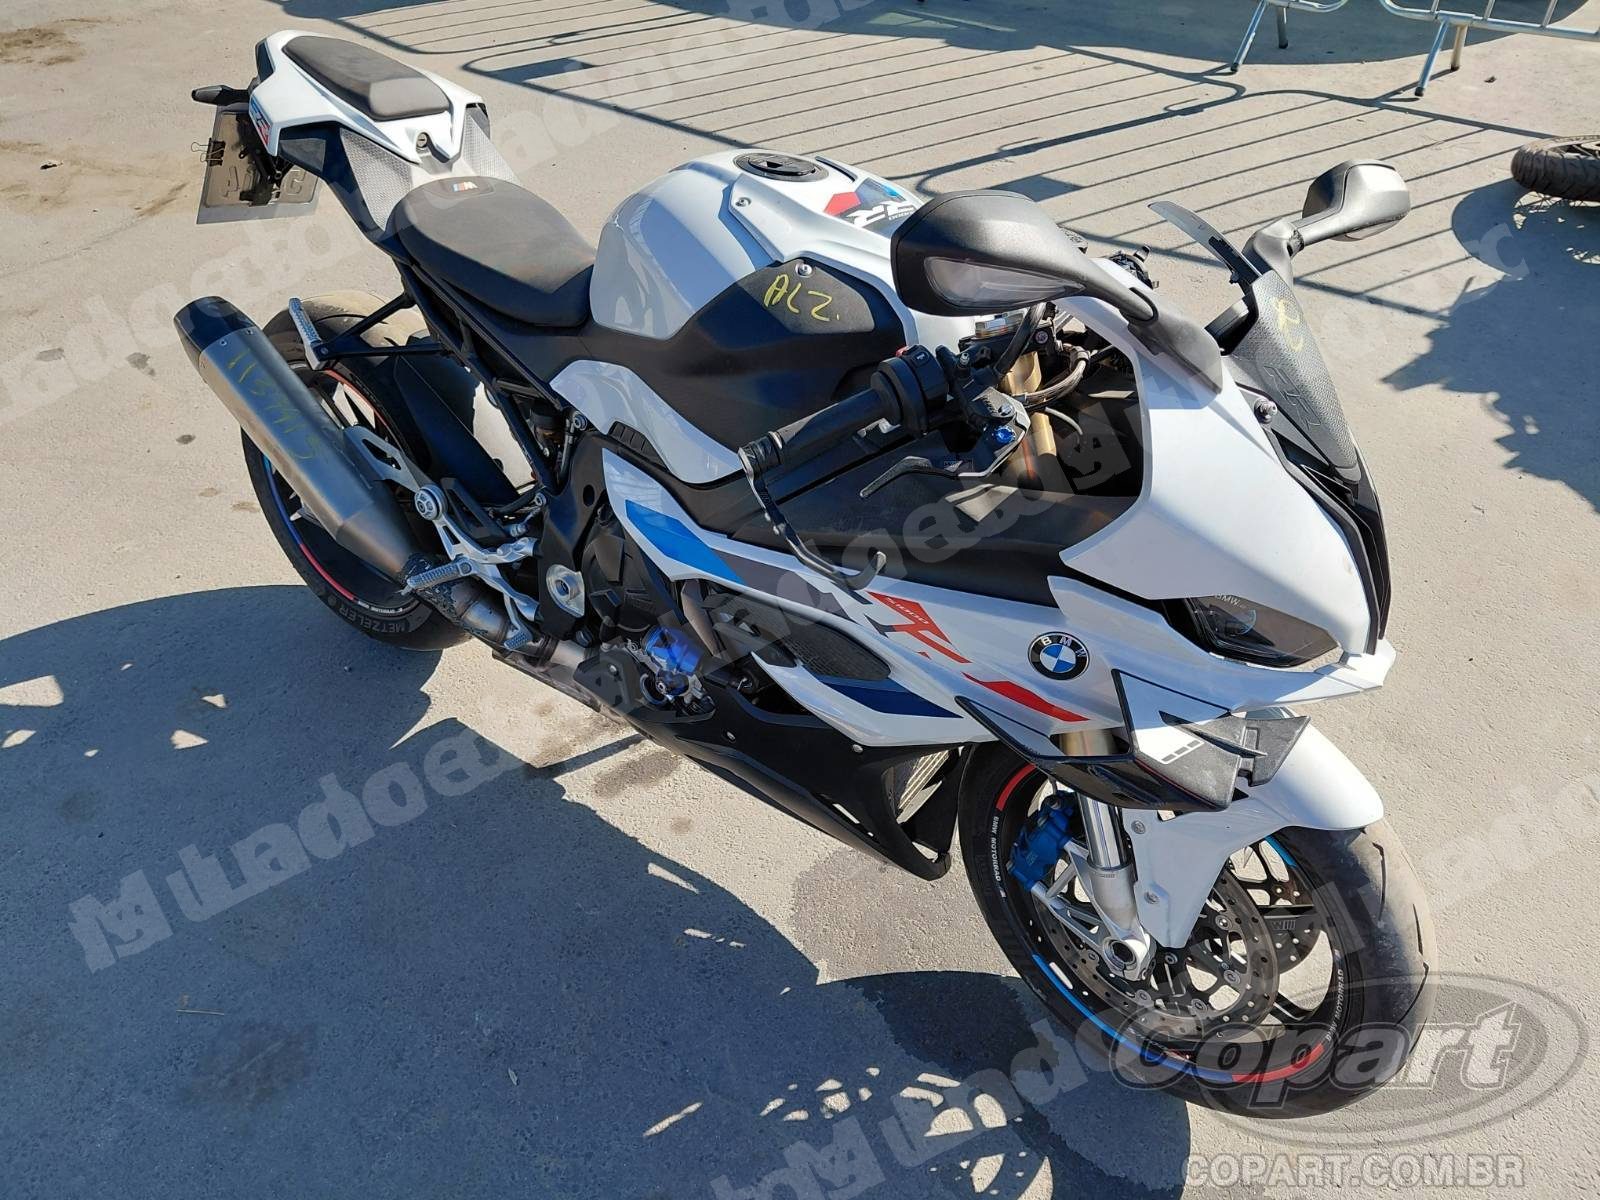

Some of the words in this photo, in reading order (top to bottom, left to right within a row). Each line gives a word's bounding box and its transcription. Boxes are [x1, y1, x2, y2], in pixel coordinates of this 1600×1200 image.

[339, 604, 406, 632] METZELER
[1040, 635, 1088, 659] BMW
[990, 836, 1002, 882] MOTORRAD
[1334, 968, 1345, 1019] MOTORRAD
